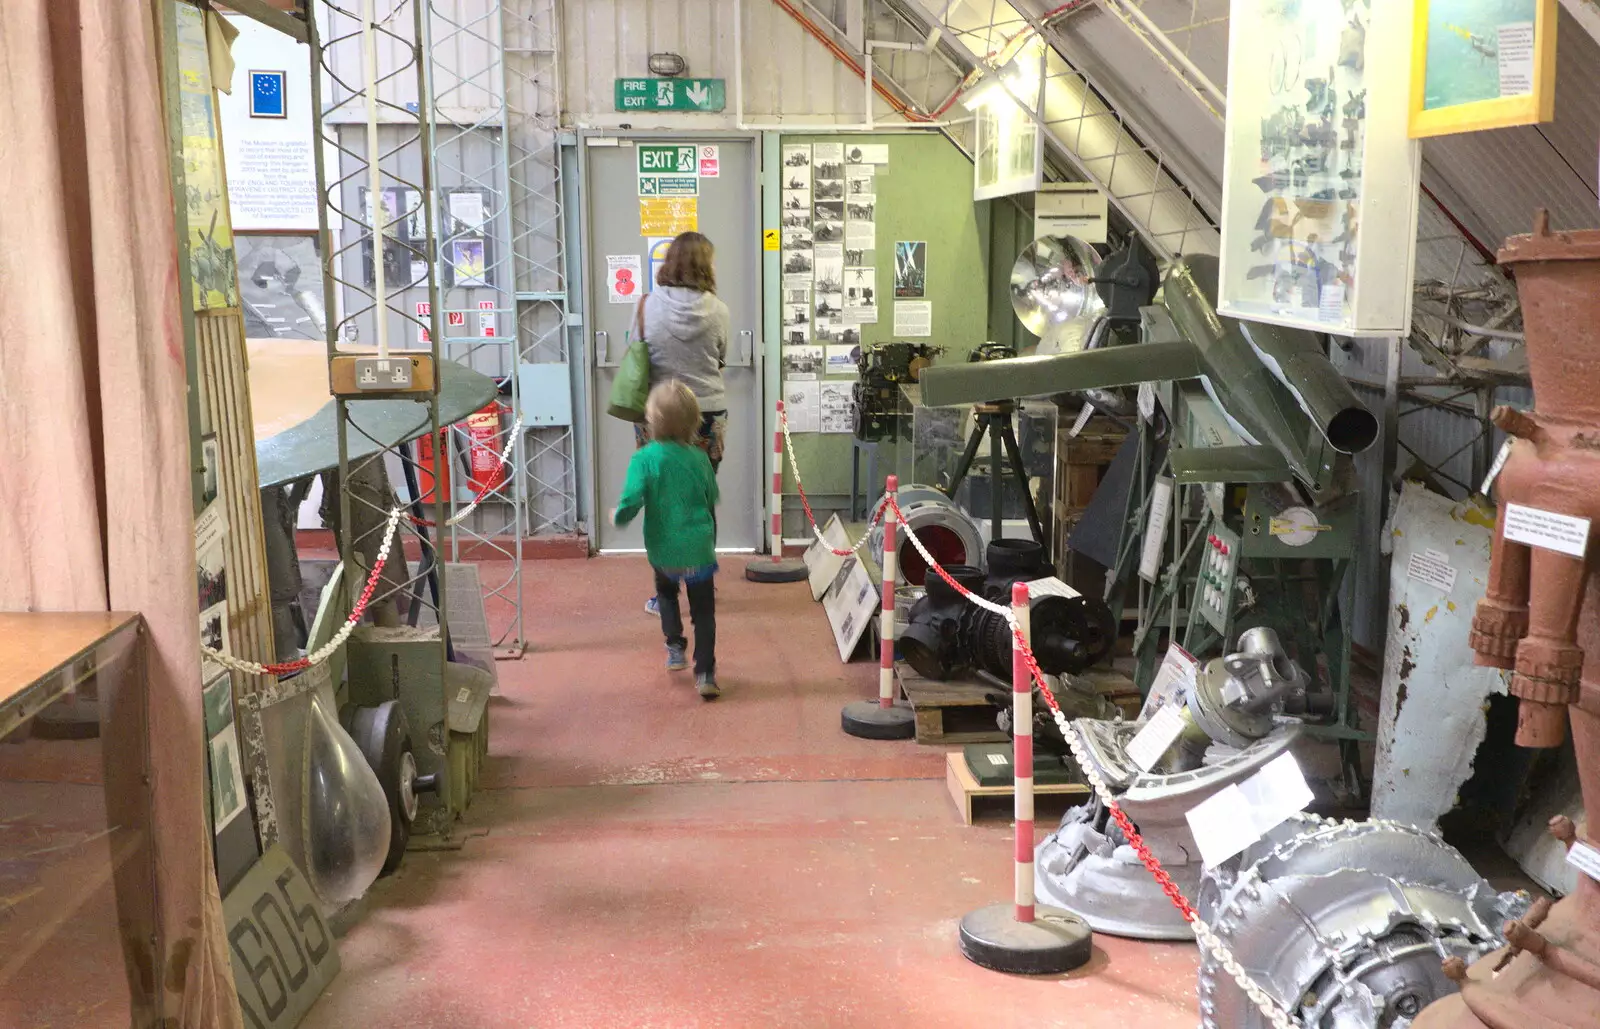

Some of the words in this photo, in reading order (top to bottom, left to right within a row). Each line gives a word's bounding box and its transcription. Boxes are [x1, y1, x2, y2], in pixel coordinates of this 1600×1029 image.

[623, 81, 646, 91] FIRE
[623, 96, 647, 106] EXIT
[642, 151, 674, 168] EXIT
